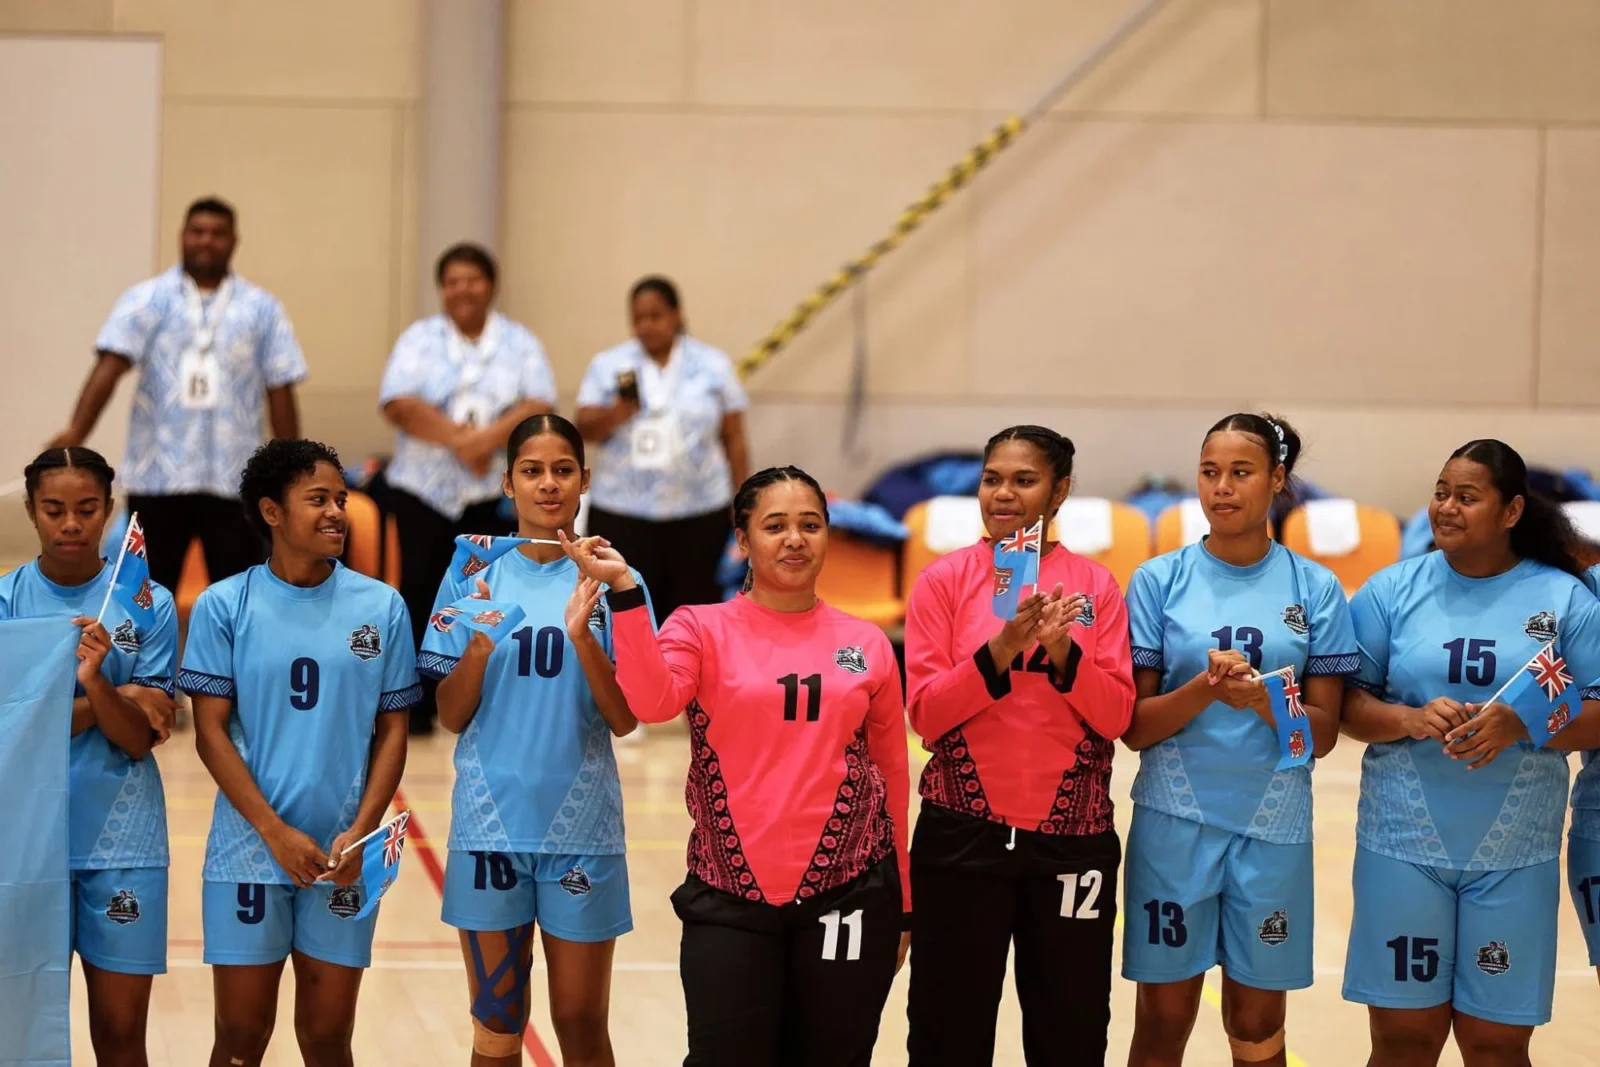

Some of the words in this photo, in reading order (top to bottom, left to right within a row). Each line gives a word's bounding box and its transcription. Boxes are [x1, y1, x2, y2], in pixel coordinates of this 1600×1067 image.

[511, 626, 565, 678] 10
[1443, 638, 1496, 687] 15
[290, 657, 320, 711] 9
[777, 673, 822, 722] 11
[469, 851, 518, 891] 10
[1056, 870, 1102, 919] 12
[236, 882, 266, 924] 9
[1143, 900, 1188, 948] 13
[818, 909, 864, 960] 11
[1386, 935, 1440, 982] 15
